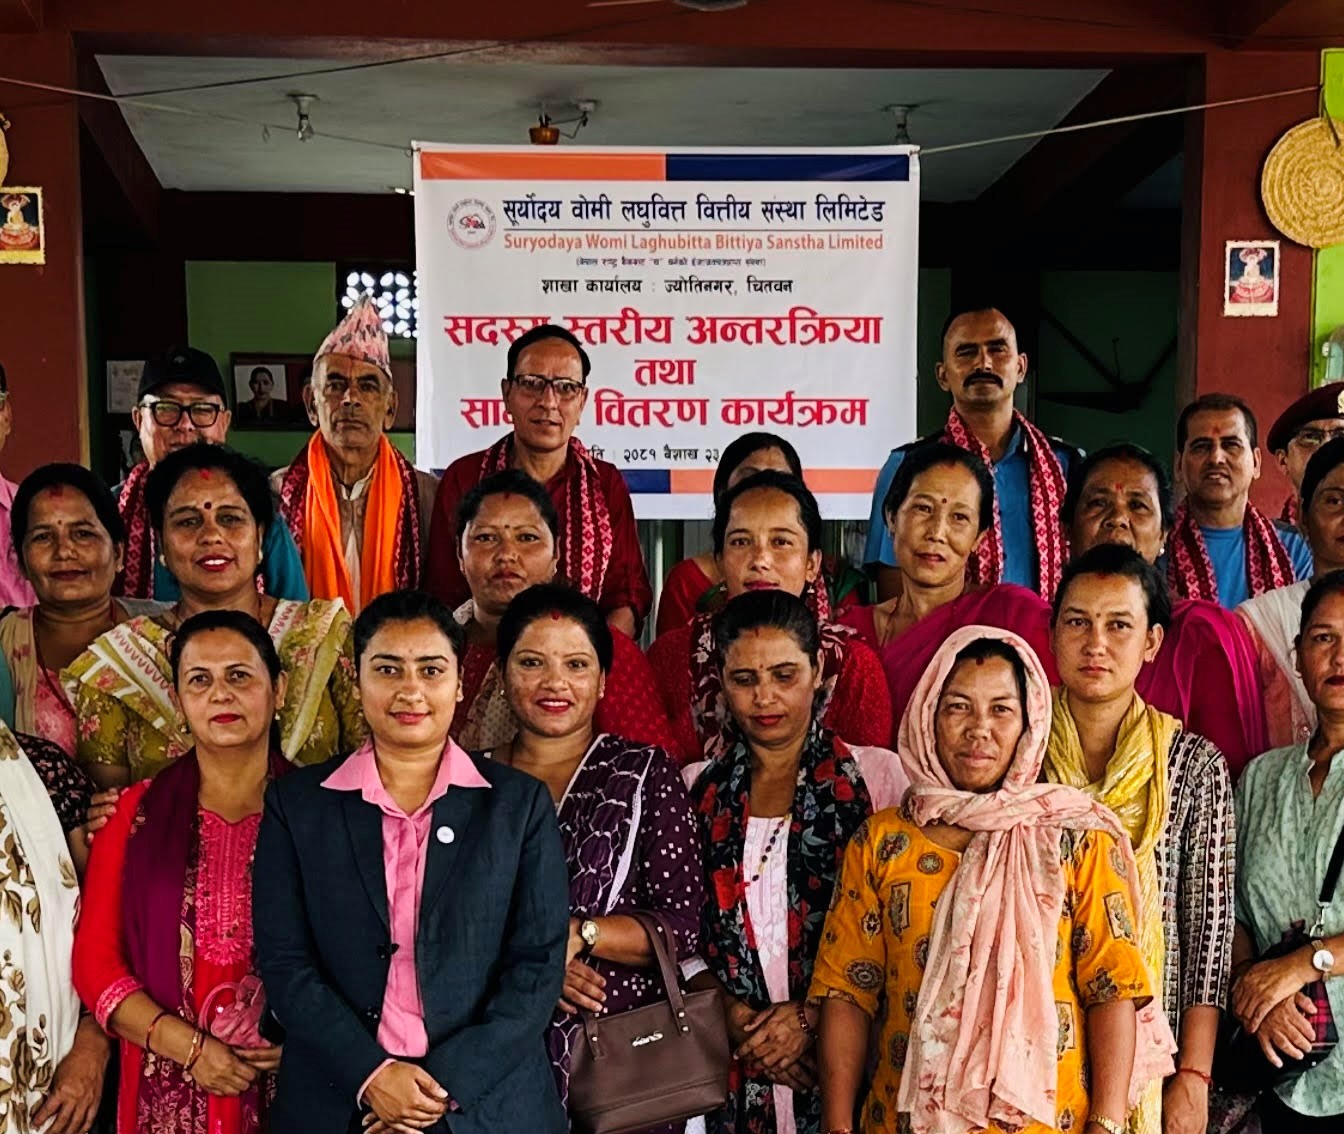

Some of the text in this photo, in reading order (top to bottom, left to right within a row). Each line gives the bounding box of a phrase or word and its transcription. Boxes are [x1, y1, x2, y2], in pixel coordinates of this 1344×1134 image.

[503, 193, 562, 226] सूर्योदय
[571, 194, 612, 220] वोमी
[621, 193, 687, 228] लघुवित्त
[696, 193, 752, 221] वित्तीय
[761, 194, 807, 222] संस्था
[815, 193, 885, 222] लिमिटेड
[504, 232, 883, 253] Suryodaya Womi Laghubitta Bittiya Sanstha Limited
[542, 280, 578, 294] शाखा
[585, 274, 643, 294] कार्यालय
[746, 275, 793, 293] चितवन
[686, 306, 883, 345] अन्तरक्रिया
[634, 359, 697, 386] तथा
[594, 388, 709, 427] वितरण
[721, 390, 869, 427] कार्यक्रम
[624, 448, 656, 463] २०८१
